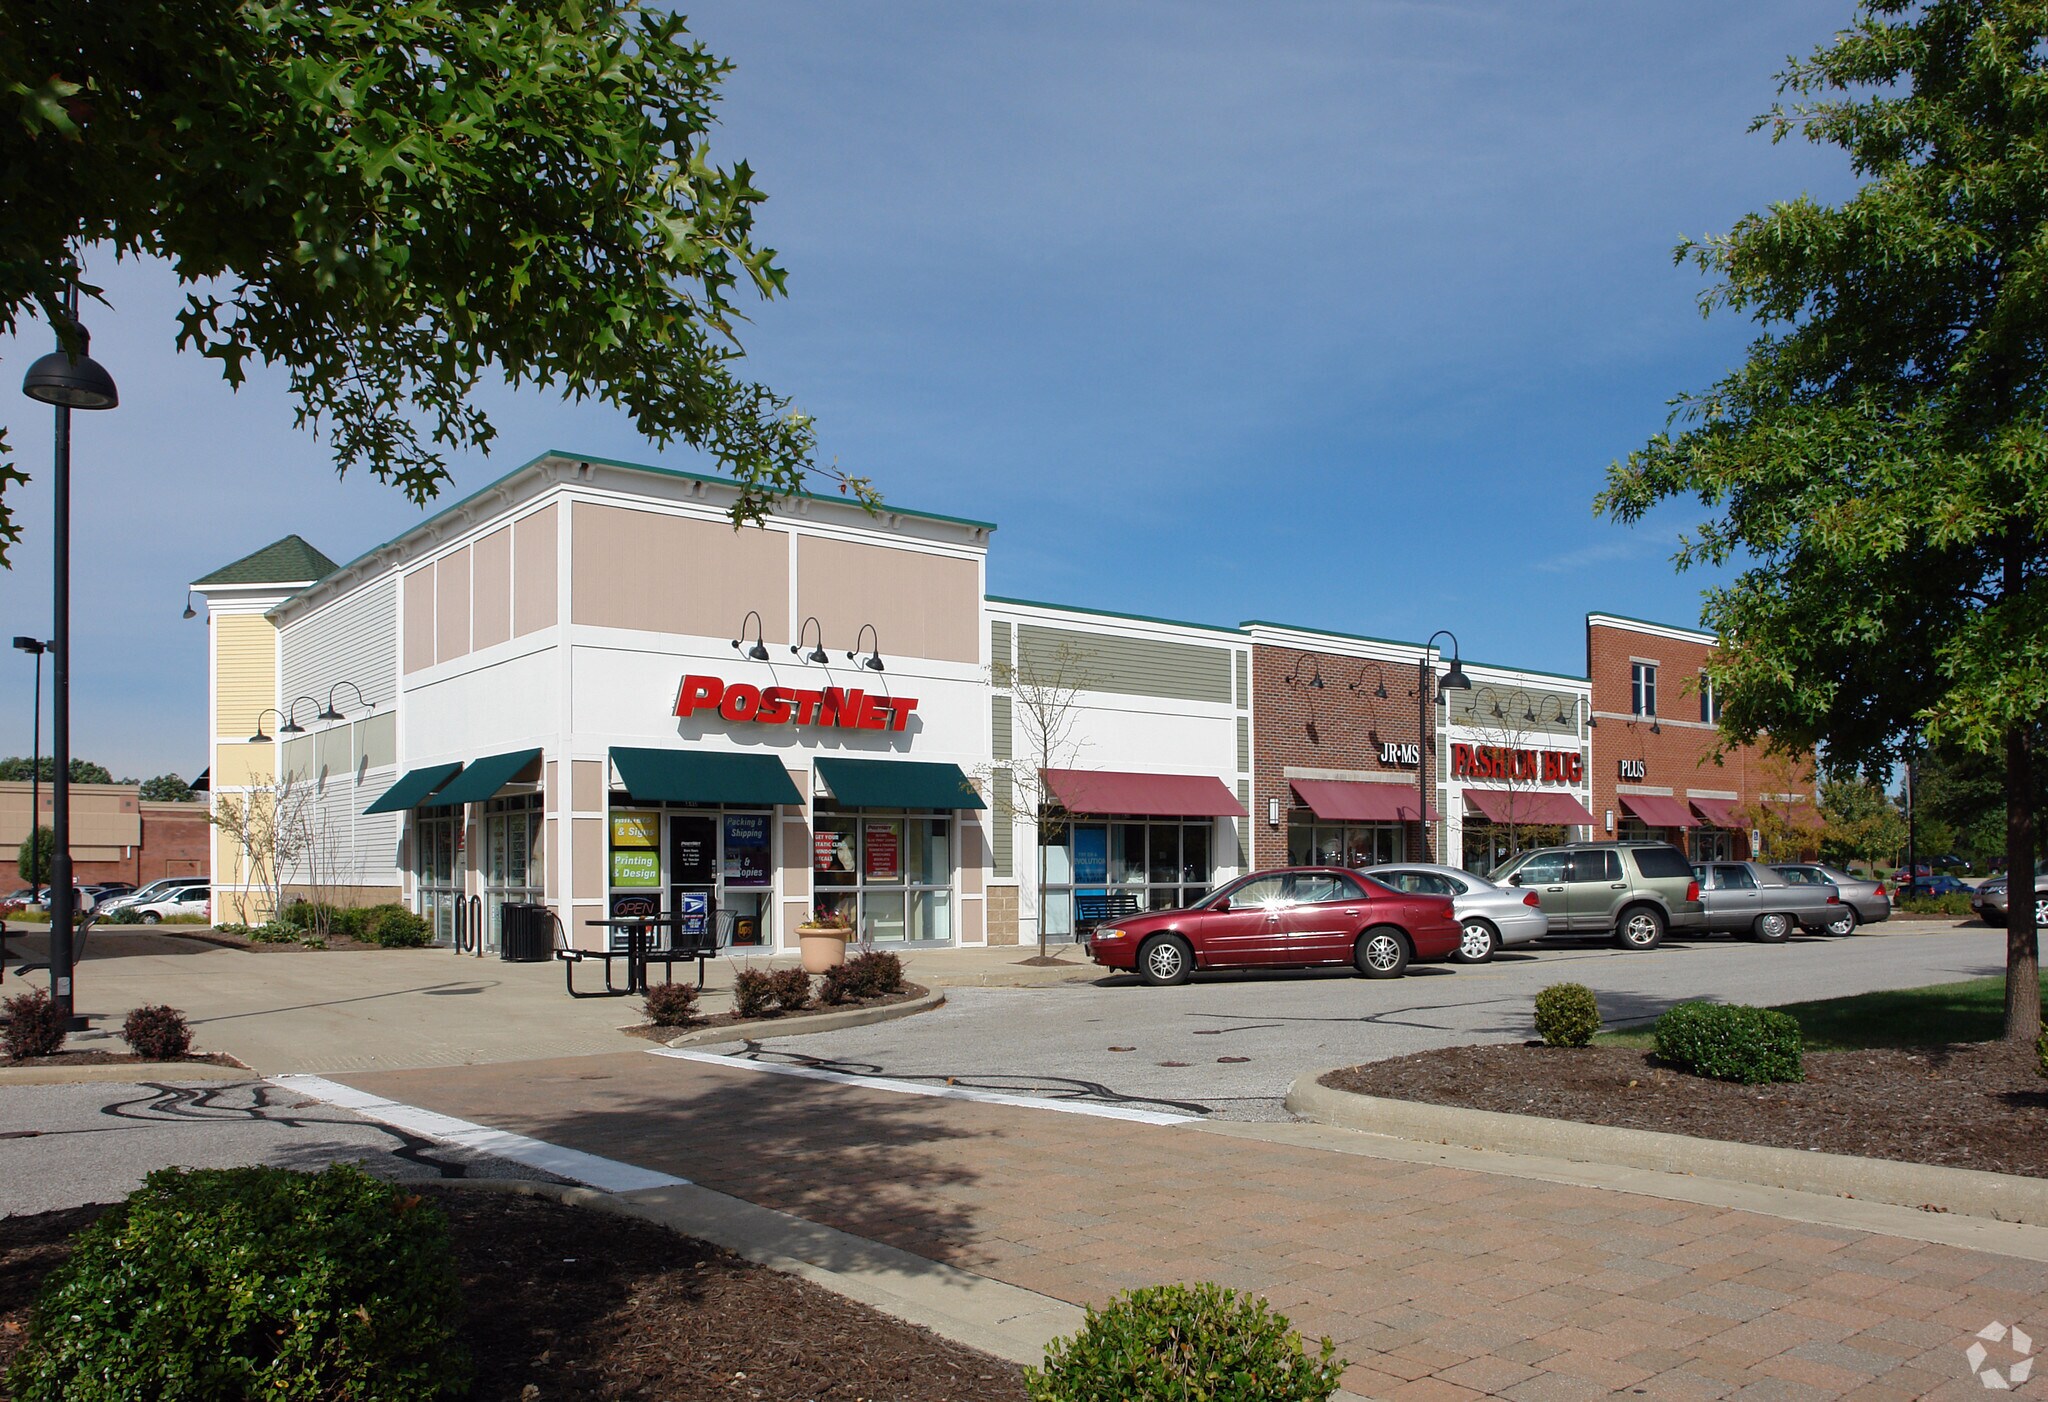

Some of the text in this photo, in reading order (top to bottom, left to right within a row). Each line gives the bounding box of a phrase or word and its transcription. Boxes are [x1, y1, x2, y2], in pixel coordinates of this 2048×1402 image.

[1453, 743, 1583, 783] FASHION BUG
[1621, 760, 1645, 778] PLUS
[727, 817, 756, 827] Packing
[617, 827, 655, 838] & Signs
[731, 828, 763, 839] Shipping
[614, 856, 653, 868] Printing
[744, 857, 751, 867] &
[613, 868, 656, 880] & Design
[739, 867, 763, 878] opies
[616, 902, 655, 915] OPEN
